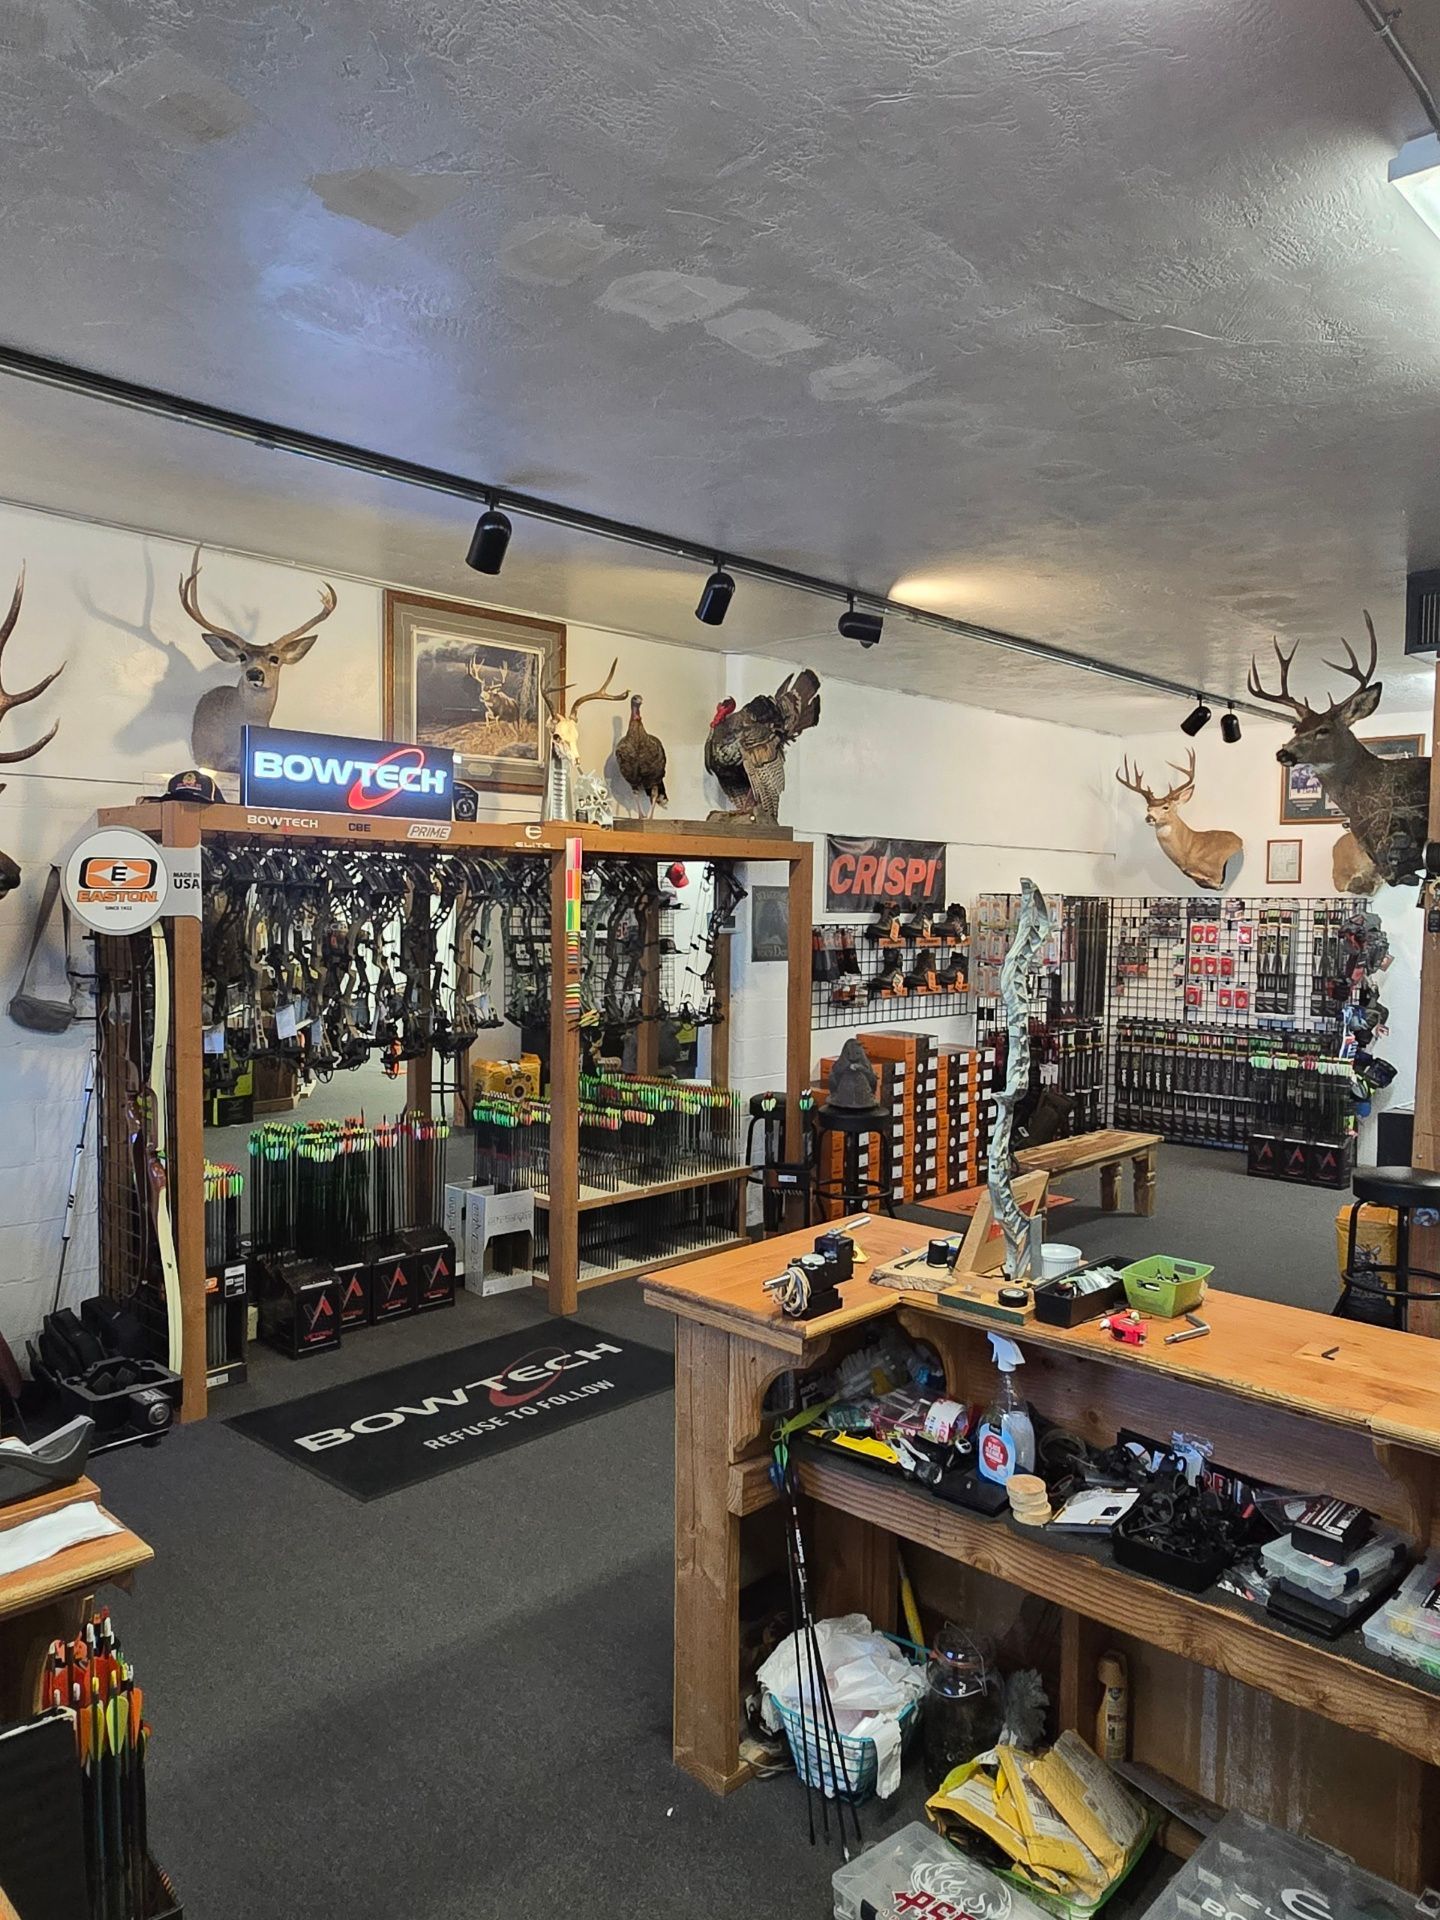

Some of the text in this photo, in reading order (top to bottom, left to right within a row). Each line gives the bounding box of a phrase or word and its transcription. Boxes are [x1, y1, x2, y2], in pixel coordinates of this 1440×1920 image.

[253, 750, 447, 795] BOWTECH
[247, 814, 318, 829] BOWTECH
[348, 822, 371, 833] CBE
[409, 825, 449, 839] PRIME
[111, 866, 128, 882] E
[829, 853, 937, 897] CRISPI
[173, 879, 200, 889] USA
[77, 890, 158, 903] EASTON
[293, 1342, 623, 1451] BOWTECH
[423, 1378, 616, 1450] REFUSE TO FOLLOW
